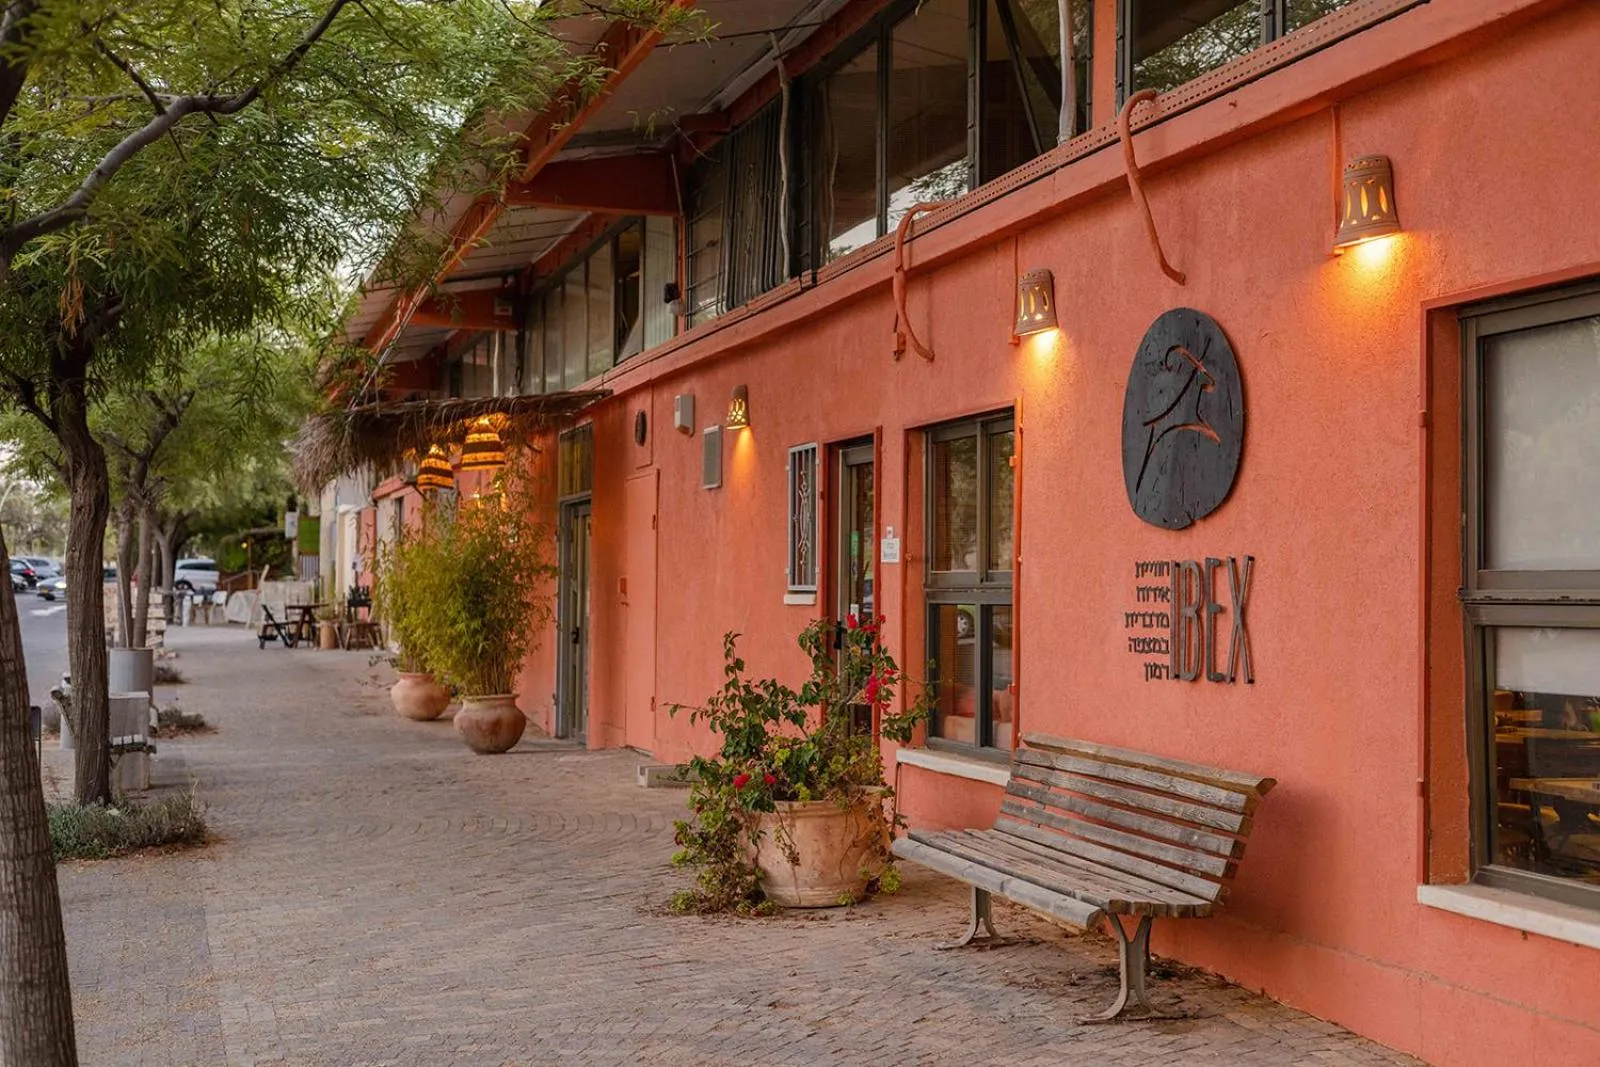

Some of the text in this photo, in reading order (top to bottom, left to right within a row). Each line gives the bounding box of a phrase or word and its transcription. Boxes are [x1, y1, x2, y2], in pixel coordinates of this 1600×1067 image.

[1136, 586, 1170, 603] אירוח
[1125, 611, 1170, 628] מדברית
[1169, 555, 1255, 684] IBEX
[1128, 636, 1170, 654] במצפה
[1144, 662, 1170, 682] רמון
